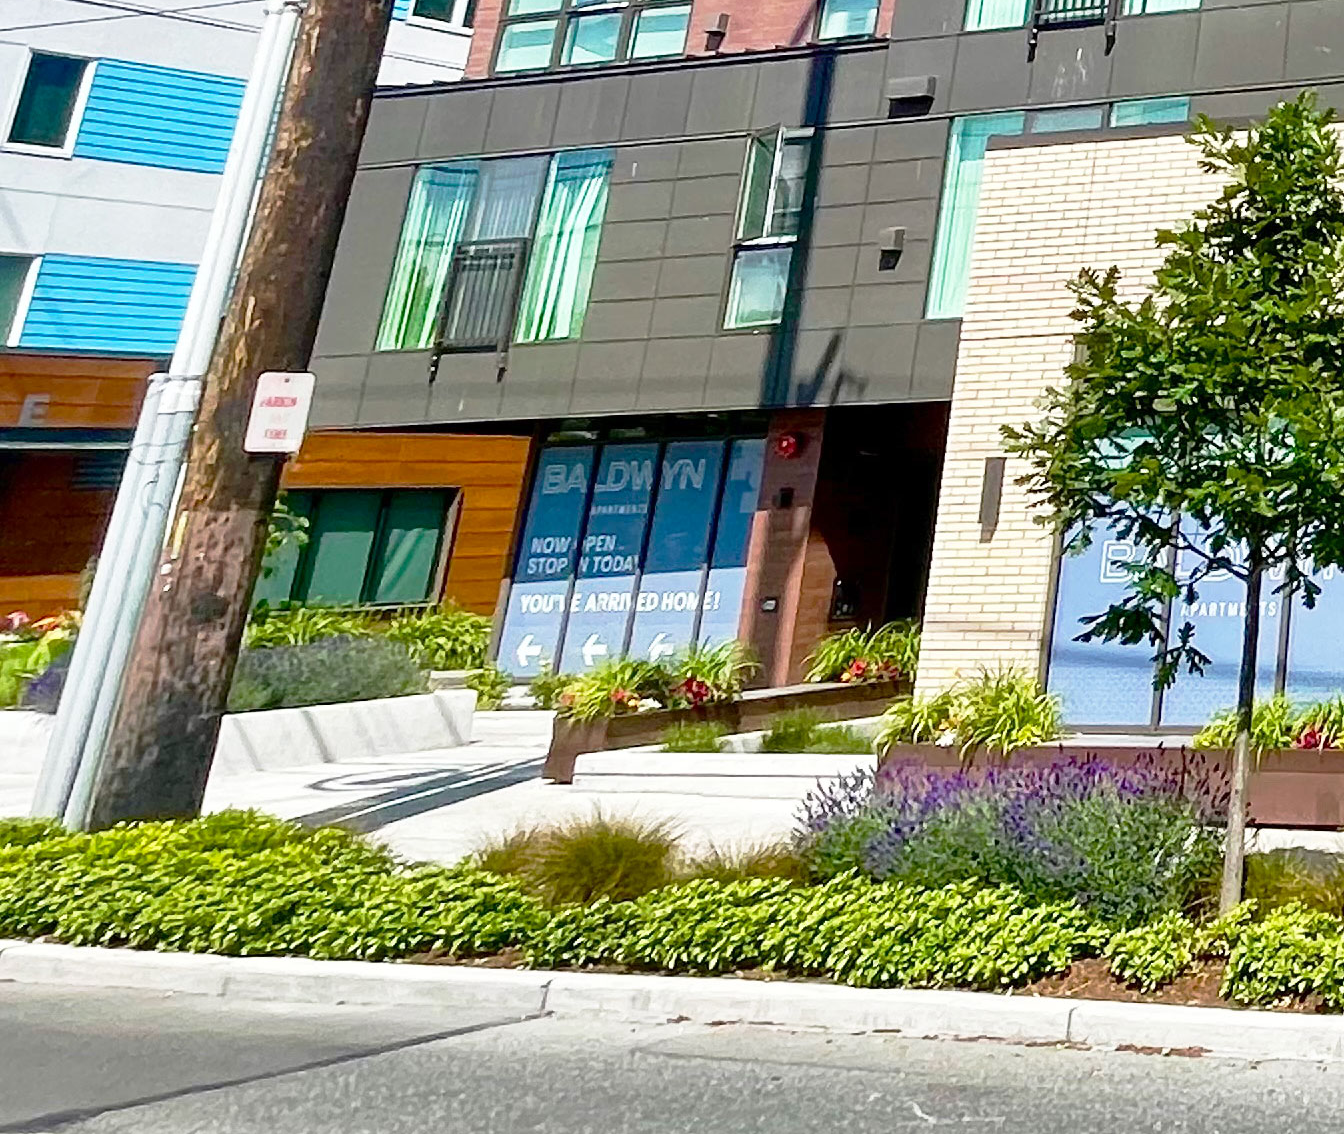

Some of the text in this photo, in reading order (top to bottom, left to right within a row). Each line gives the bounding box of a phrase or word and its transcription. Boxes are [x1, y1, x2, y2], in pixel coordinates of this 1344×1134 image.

[531, 536, 571, 554] NOW
[527, 557, 568, 574] STOP
[660, 590, 721, 612] HOME!
[1181, 601, 1277, 617] APARTMETS
